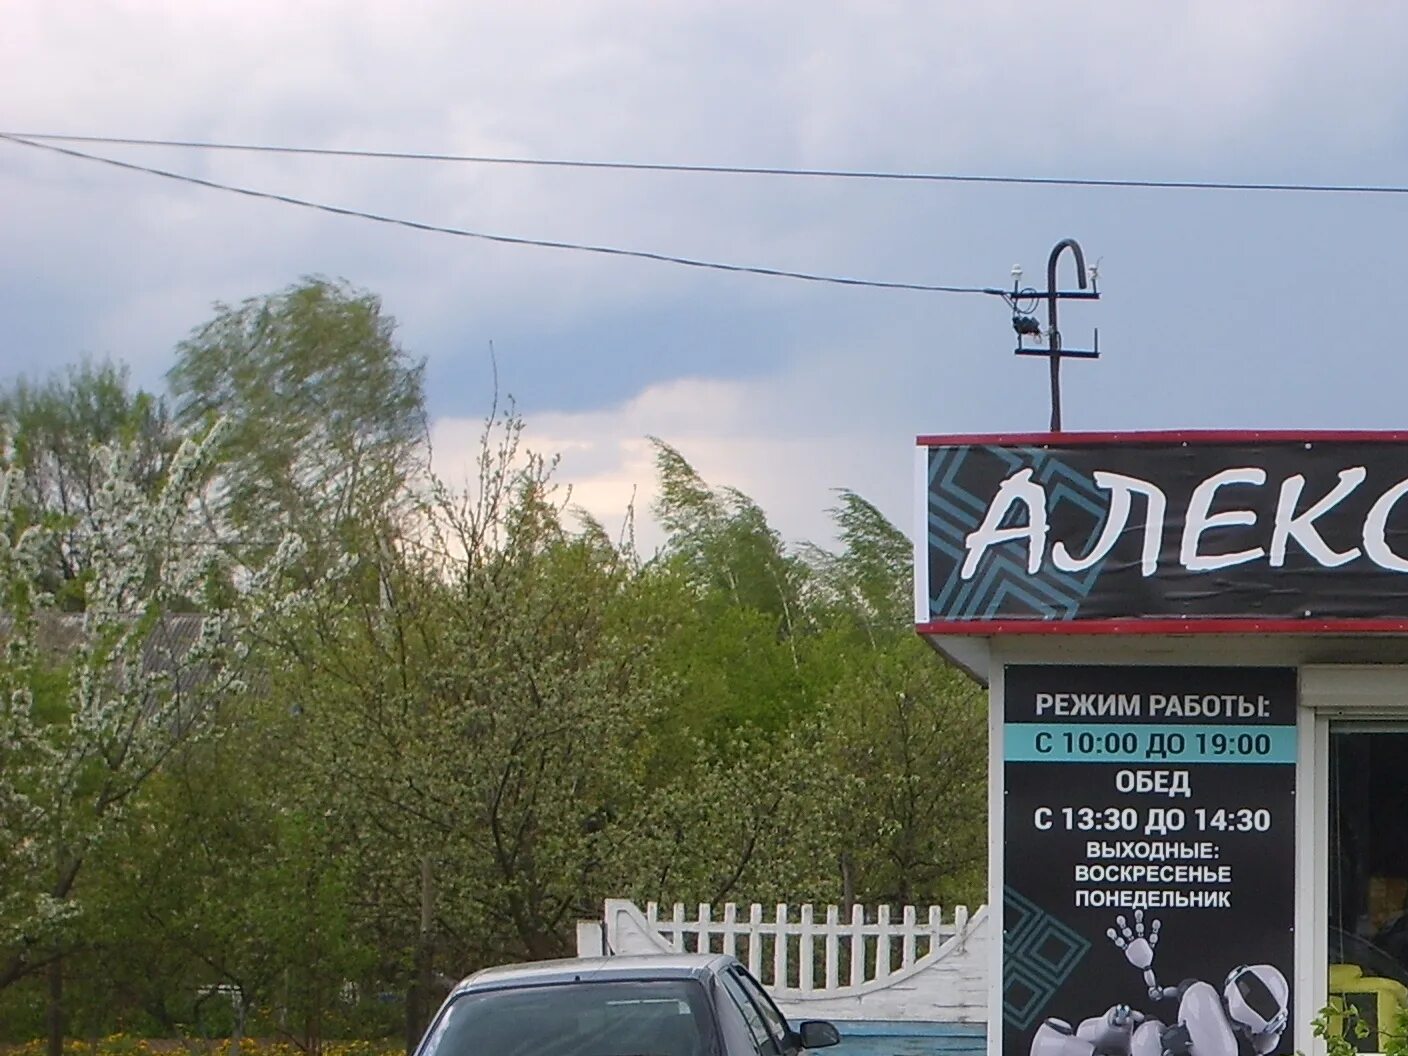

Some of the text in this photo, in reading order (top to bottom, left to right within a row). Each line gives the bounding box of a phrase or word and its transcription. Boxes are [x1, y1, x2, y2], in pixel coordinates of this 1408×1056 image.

[1035, 693, 1270, 718] РЕЖИМ РАБОТЫ:
[1035, 732, 1271, 759] С 10:00 ДО 19:00
[1115, 770, 1192, 798] ОБЕД
[1034, 807, 1271, 836] С 13:30 ДО 14:30
[1086, 841, 1220, 861] ВЫХОДНЫЕ:
[1075, 865, 1232, 883] ВОСКРЕСЕНЬЕ
[1075, 890, 1232, 910] ПОНЕДЕЛЬНИК
